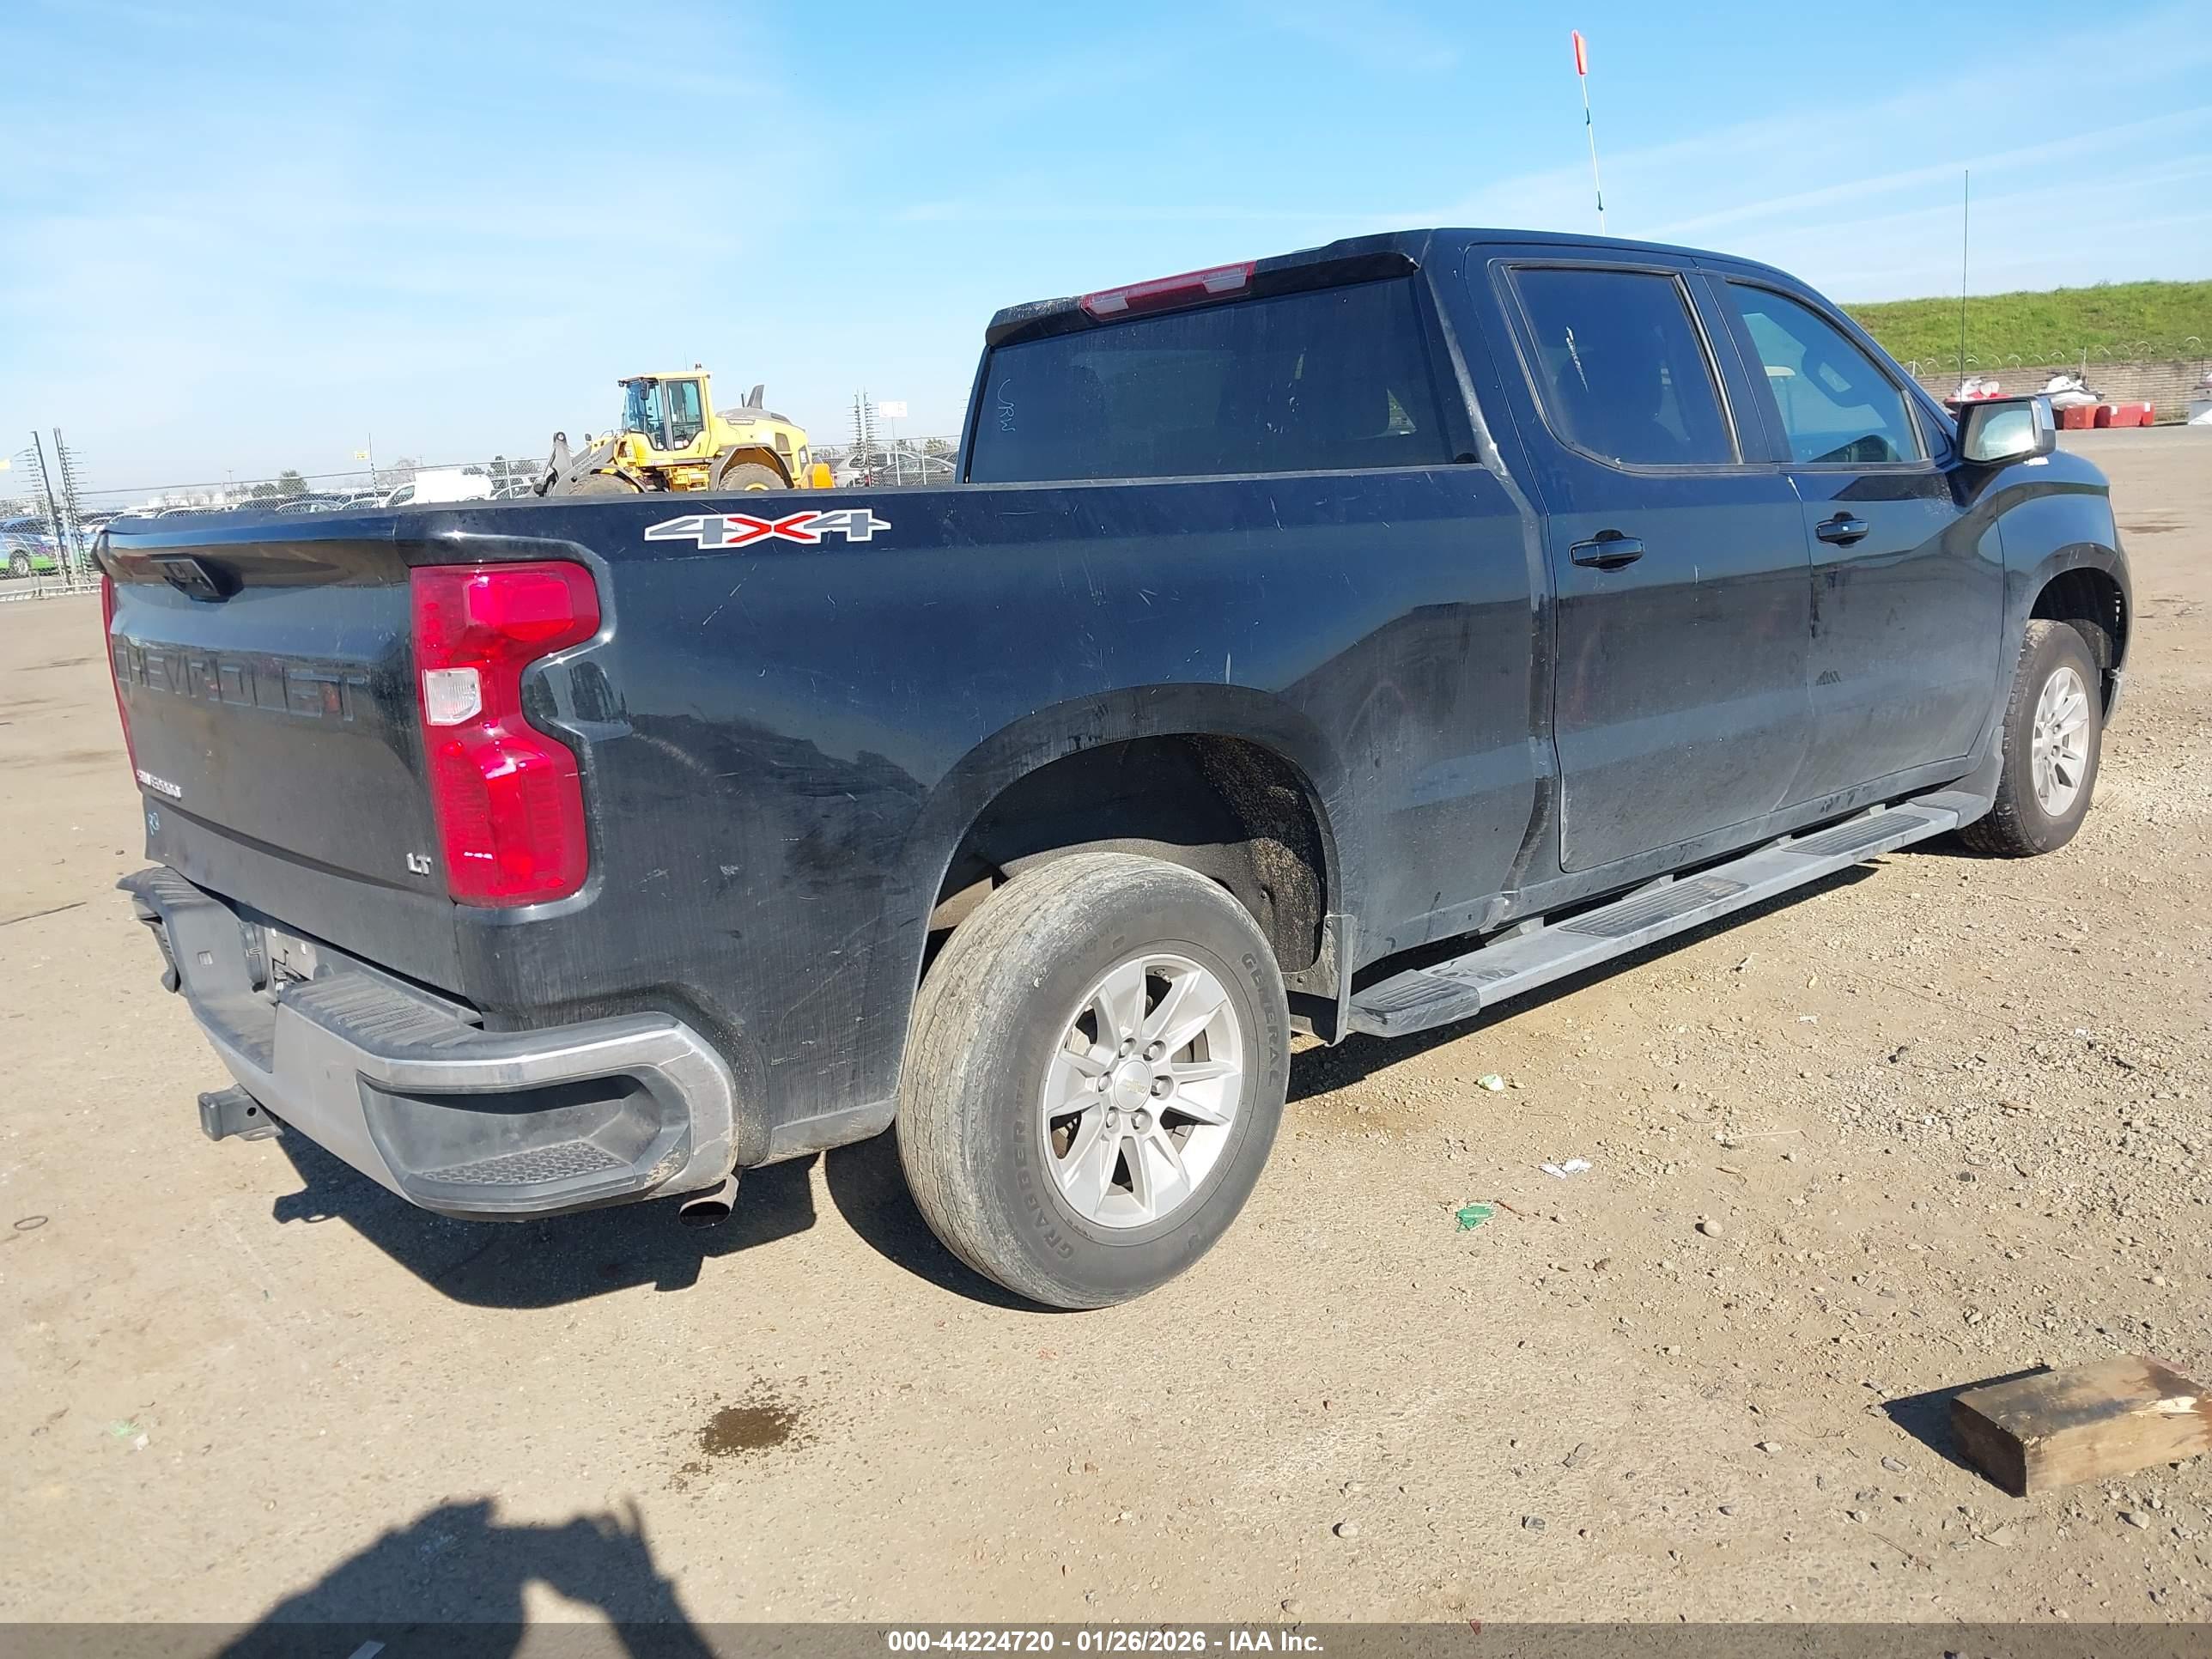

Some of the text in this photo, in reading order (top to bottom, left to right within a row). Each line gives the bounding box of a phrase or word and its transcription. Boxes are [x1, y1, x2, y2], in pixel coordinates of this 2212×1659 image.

[112, 635, 373, 722] CHEVROLET
[406, 852, 433, 875] LT
[1241, 951, 1280, 1087] GENERAL
[1012, 1120, 1075, 1260] GRABBER
